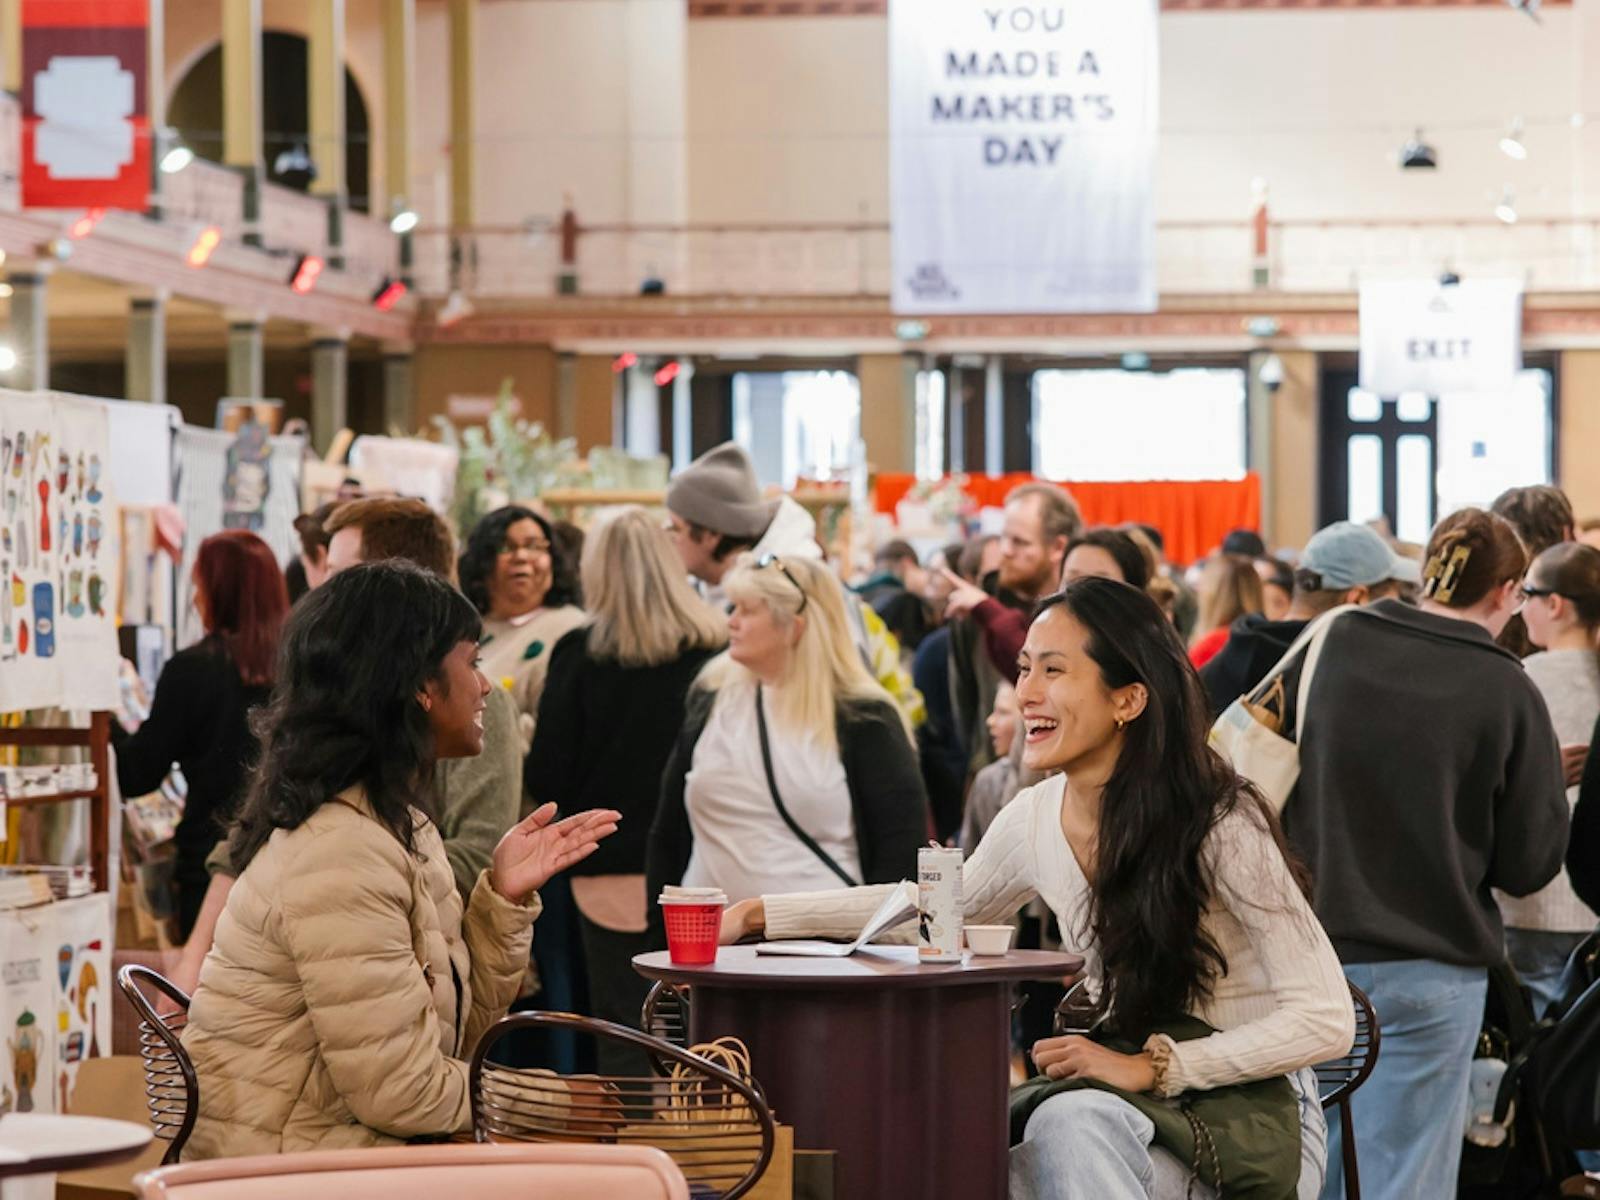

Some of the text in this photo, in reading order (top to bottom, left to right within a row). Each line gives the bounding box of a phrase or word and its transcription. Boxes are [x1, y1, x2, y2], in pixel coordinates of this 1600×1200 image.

[984, 7, 1065, 31] YOU
[945, 49, 1100, 77] MADE A
[931, 94, 1115, 121] MAKER'S
[983, 136, 1064, 165] DAY
[1406, 337, 1472, 361] EXIT
